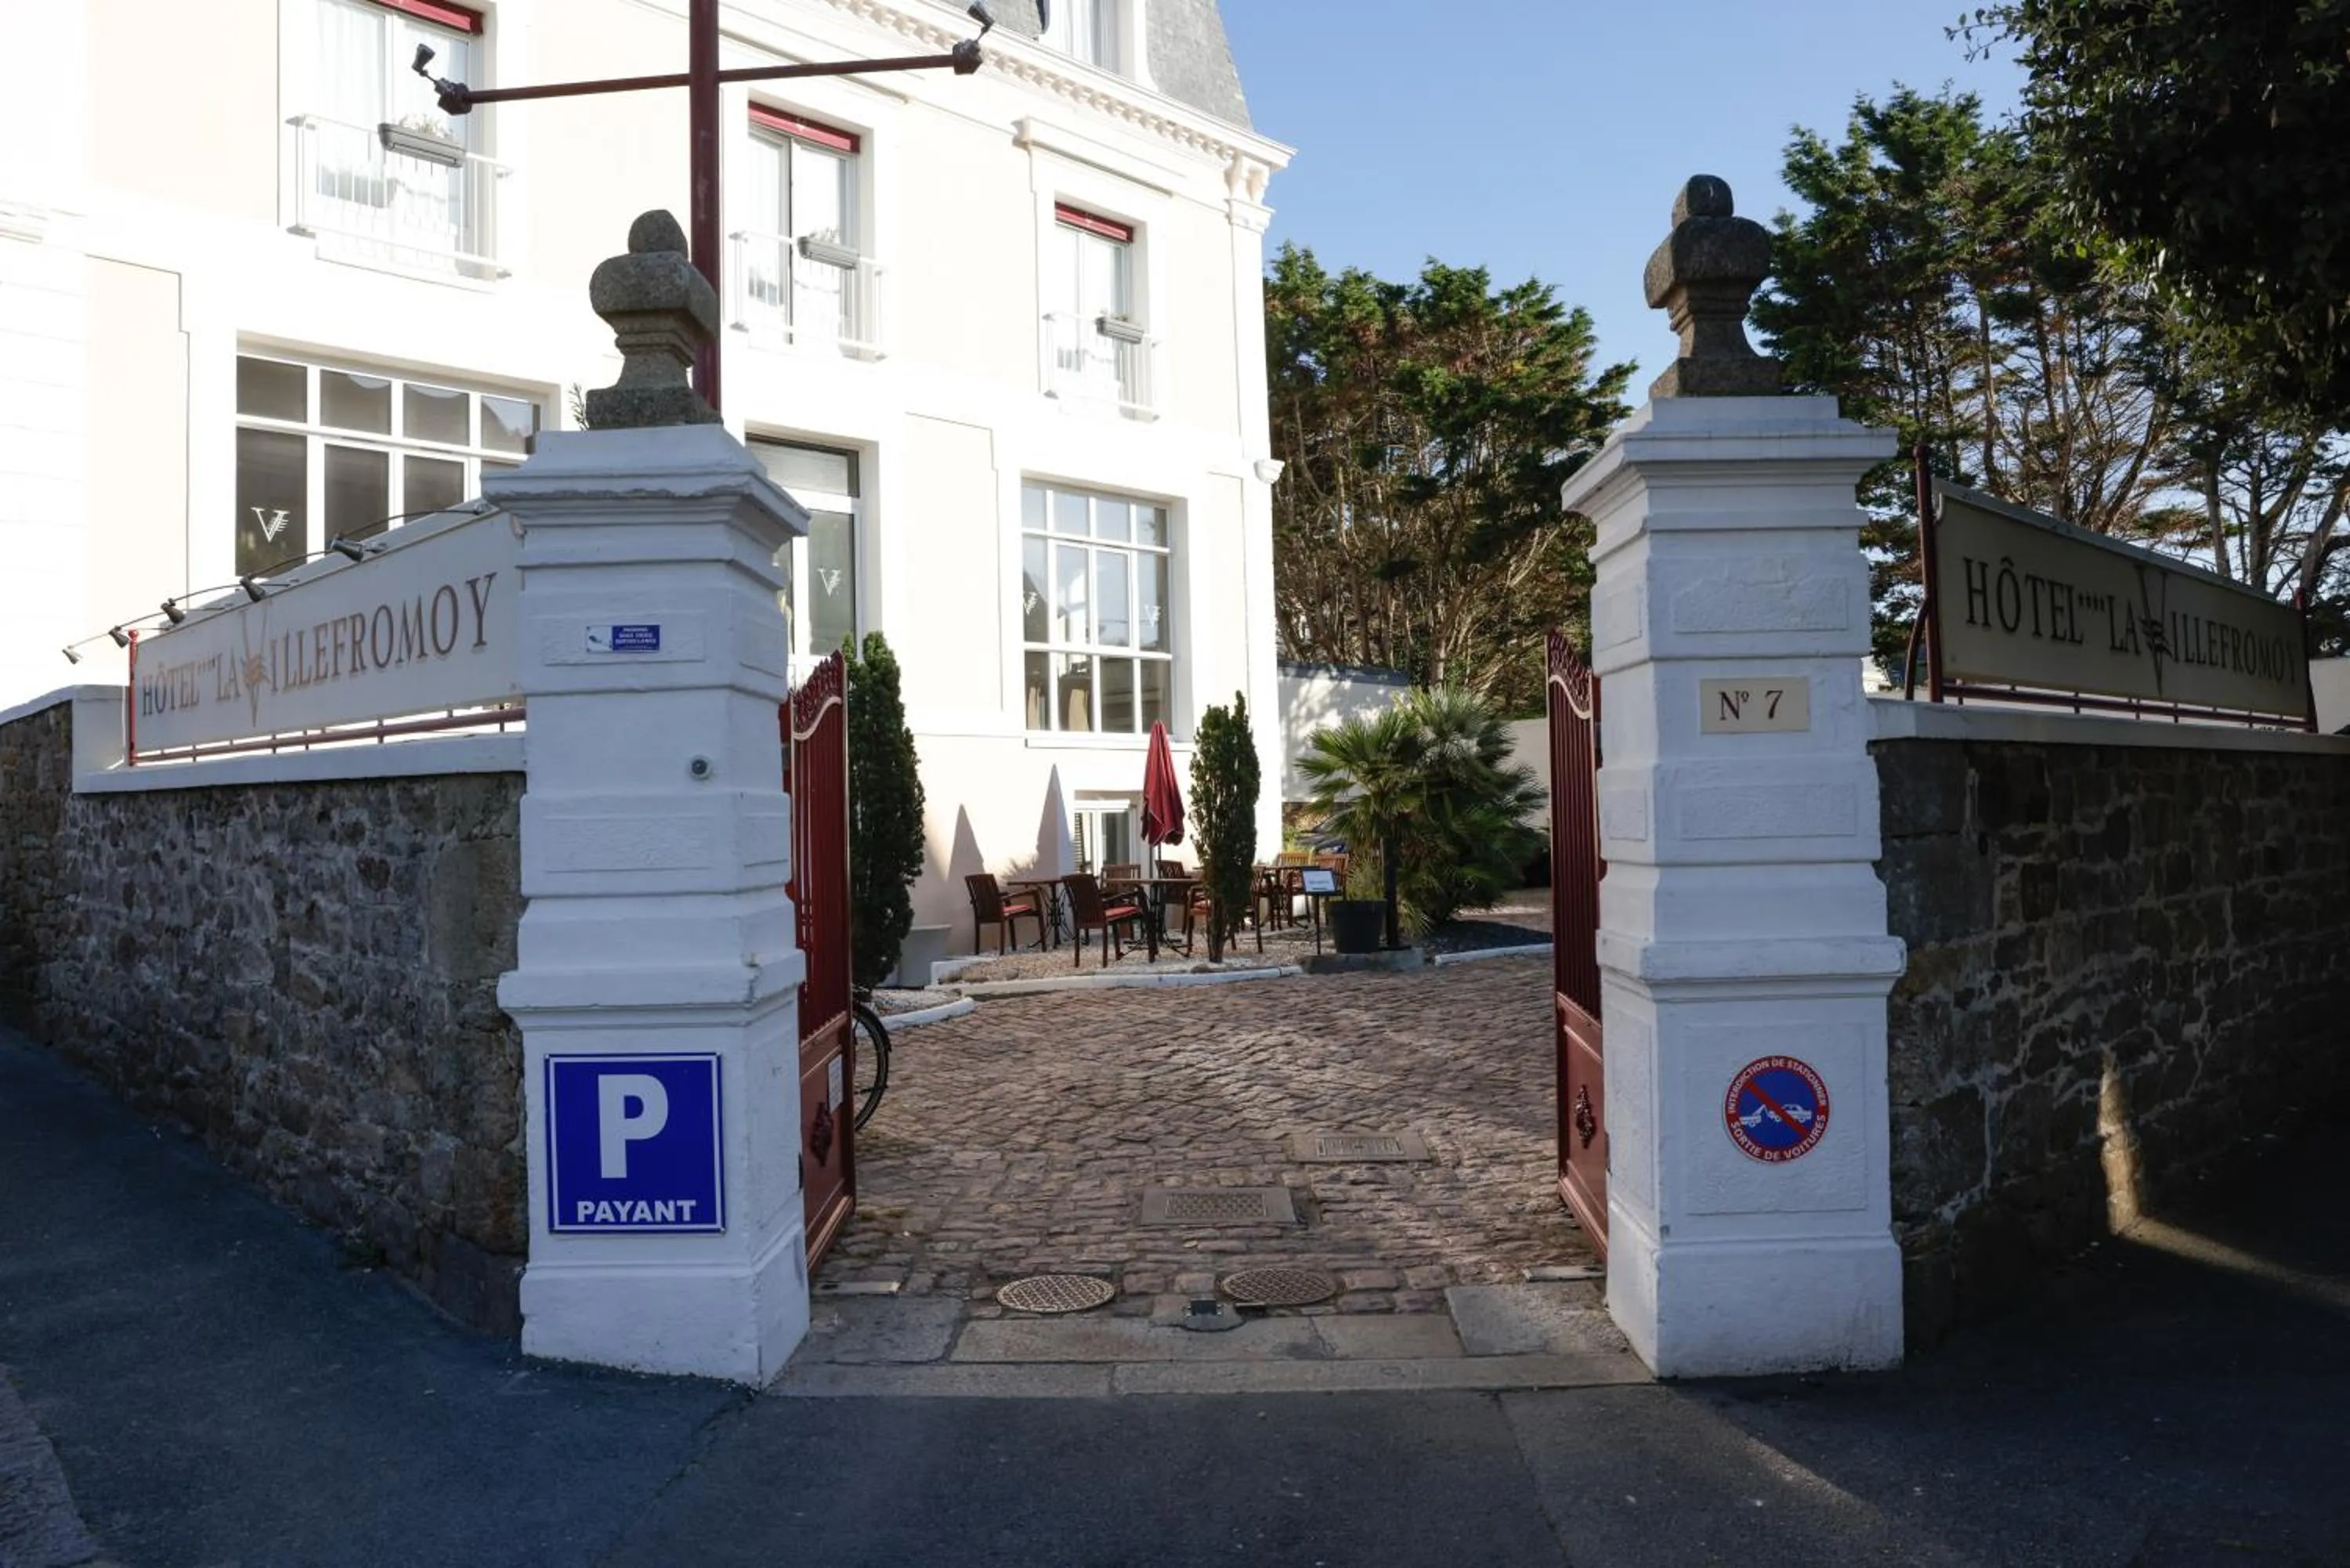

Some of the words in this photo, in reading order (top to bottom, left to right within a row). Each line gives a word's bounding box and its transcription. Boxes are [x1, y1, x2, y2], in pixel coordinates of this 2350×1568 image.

[1963, 555, 2084, 646] HÔTEL
[2107, 595, 2142, 656] LA
[142, 661, 200, 717] HÔTEL
[215, 645, 241, 702] LA
[1764, 689, 1784, 720] 7
[1728, 1060, 1770, 1114] INTERDICTION
[1771, 1058, 1785, 1068] DE
[598, 1074, 669, 1179] P
[1730, 1121, 1762, 1158] SORTIE
[1764, 1151, 1781, 1161] DE
[1783, 1115, 1827, 1159] VOITURES
[577, 1199, 697, 1223] PAYANT
